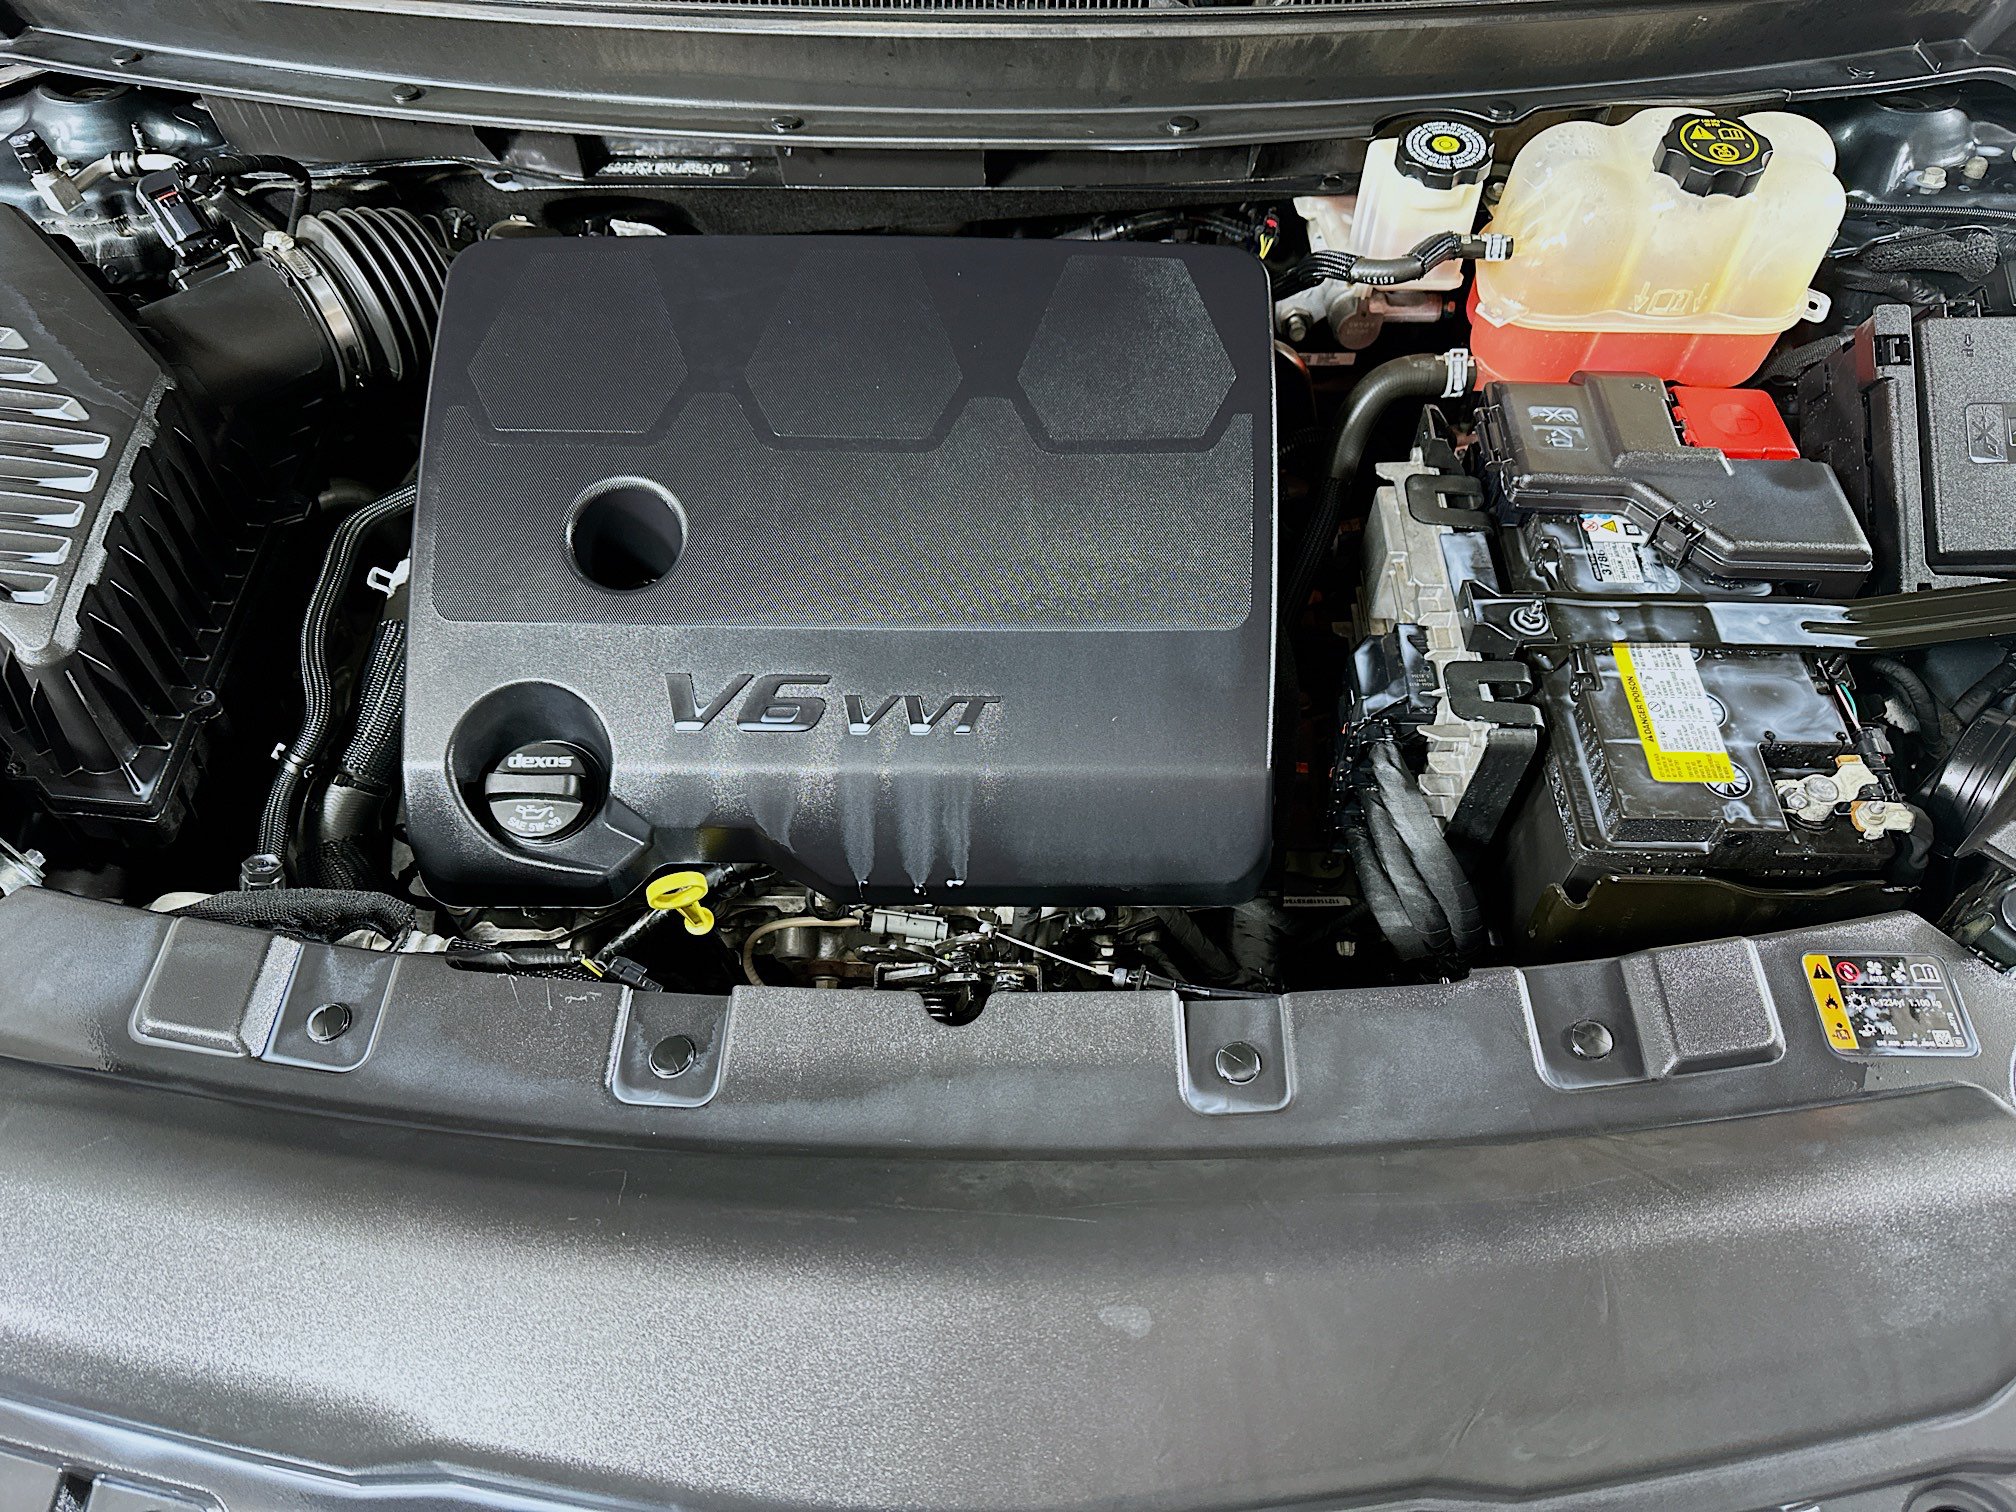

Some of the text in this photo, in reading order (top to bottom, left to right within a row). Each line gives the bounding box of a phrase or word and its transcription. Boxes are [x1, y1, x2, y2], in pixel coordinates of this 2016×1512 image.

[1596, 549, 1612, 576] 3786
[664, 672, 1002, 736] V6 VVT
[1627, 675, 1652, 734] DANGER POISON
[507, 753, 575, 768] dexos
[507, 816, 562, 832] SAE 5W-30
[1869, 975, 1888, 983] AUTO
[1869, 998, 1905, 1009] R-1234yf
[1930, 999, 1943, 1009] kg
[1880, 1024, 1898, 1035] PAG
